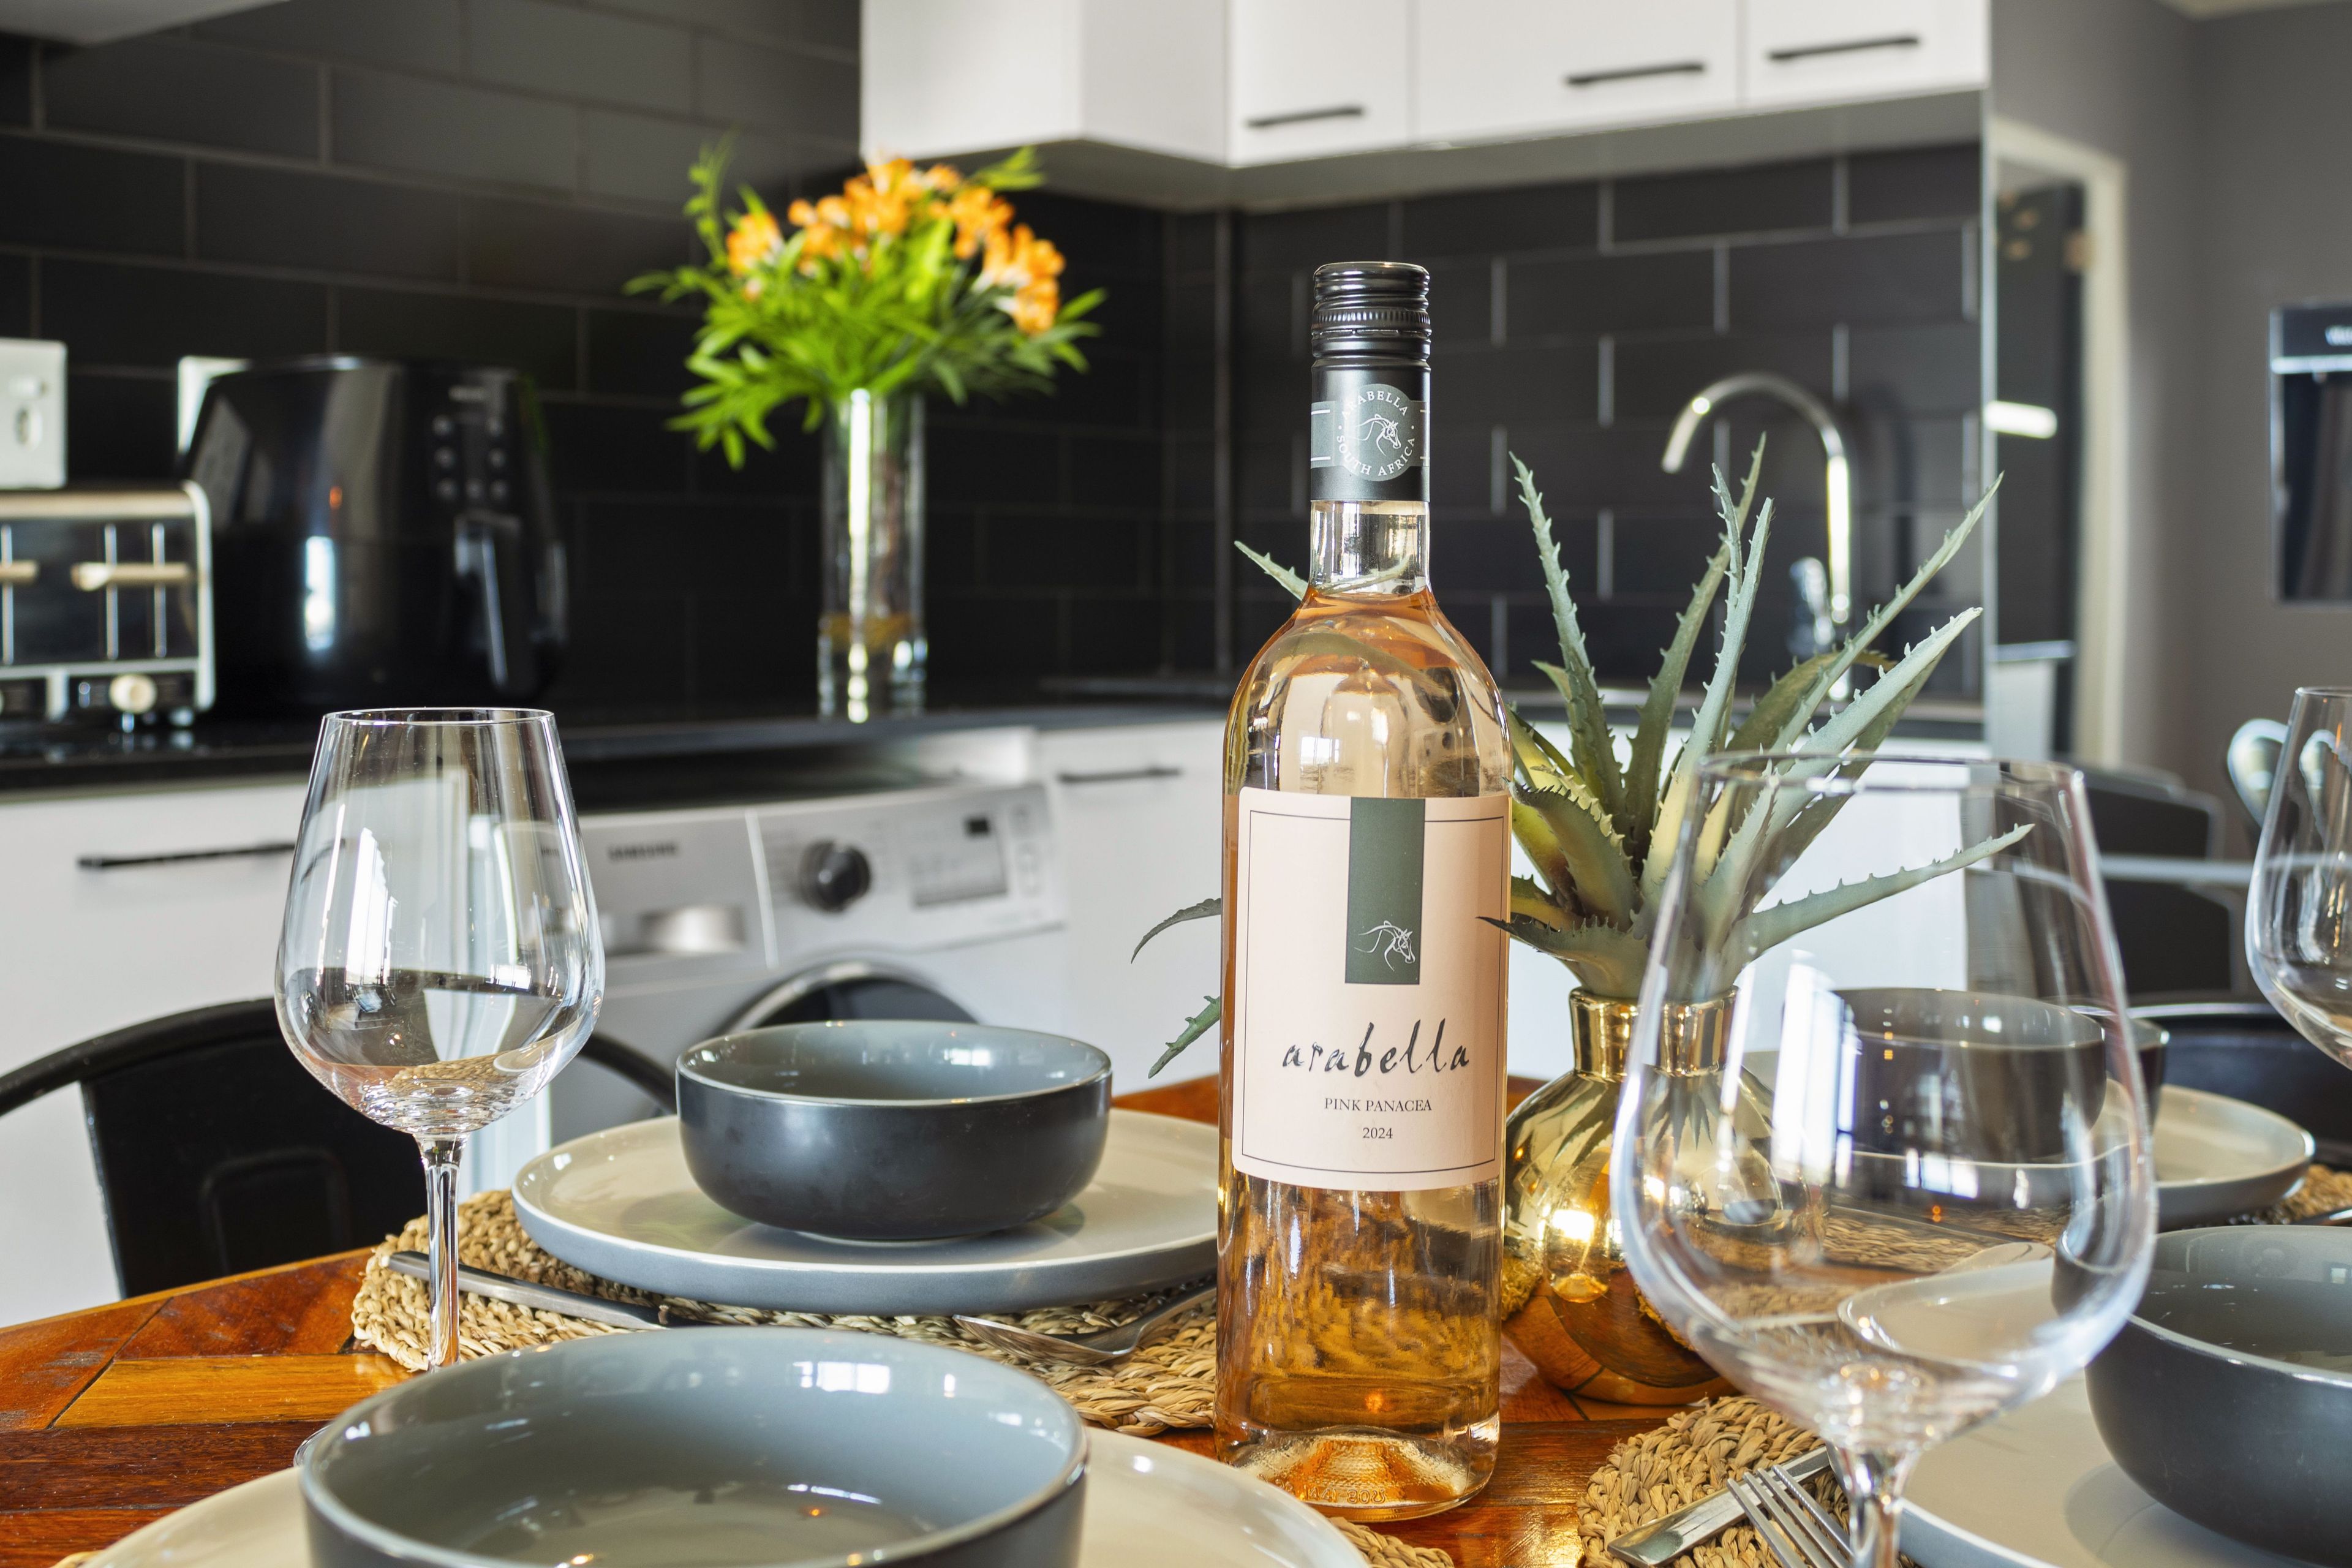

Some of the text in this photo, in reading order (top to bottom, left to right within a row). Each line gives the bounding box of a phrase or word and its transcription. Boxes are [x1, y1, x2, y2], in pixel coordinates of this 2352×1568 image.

[1341, 390, 1408, 420] ARABELLA
[1336, 435, 1415, 477] SOUTH AFRICA
[1282, 1017, 1469, 1077] arabella
[1324, 1097, 1432, 1112] PINK PANACEA
[1362, 1127, 1393, 1139] 2024
